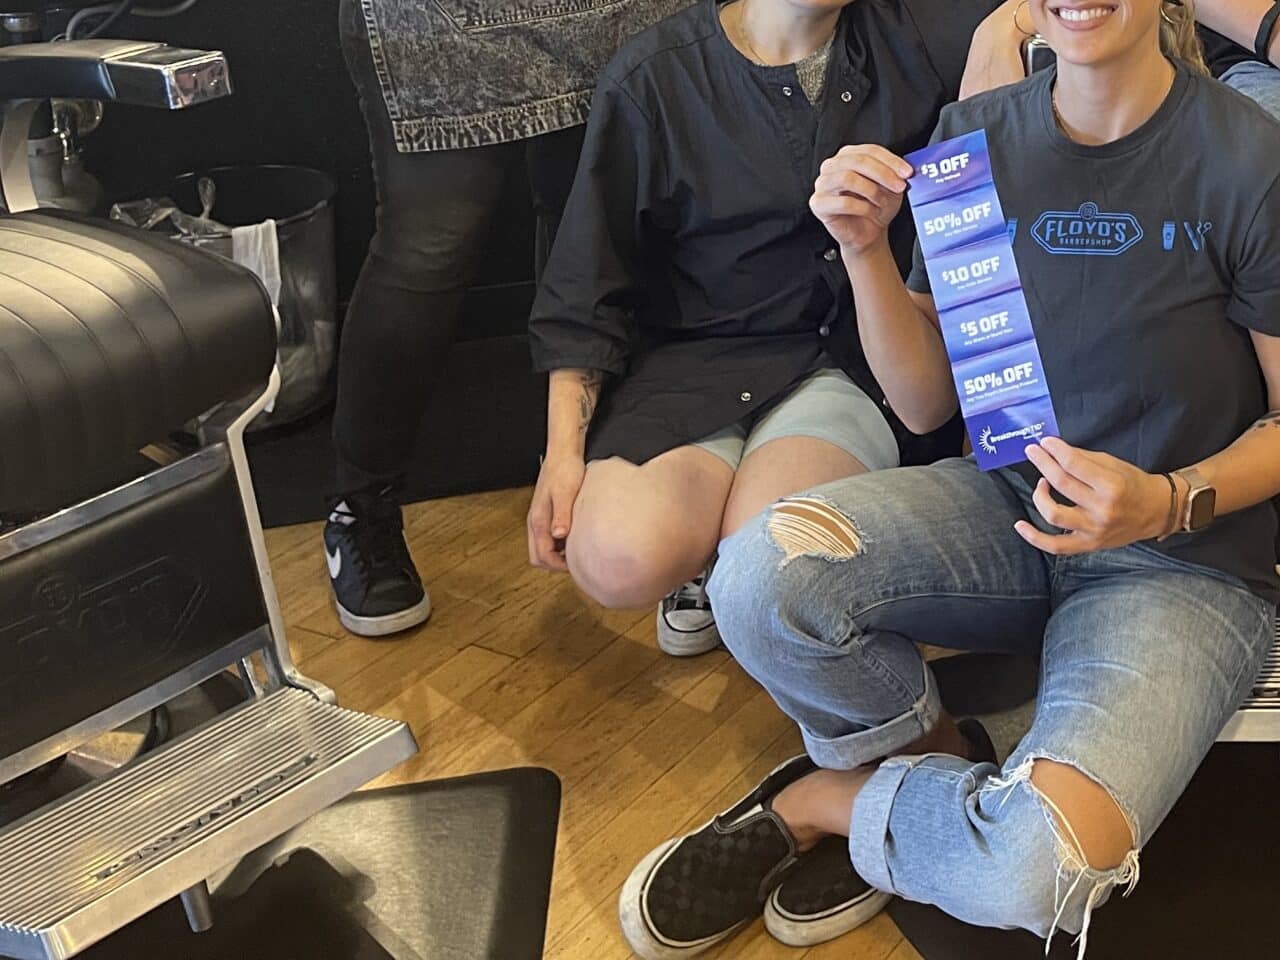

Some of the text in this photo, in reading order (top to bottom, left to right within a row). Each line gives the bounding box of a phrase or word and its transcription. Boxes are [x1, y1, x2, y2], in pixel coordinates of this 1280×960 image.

[921, 152, 970, 179] $3 OFF
[923, 213, 961, 236] 50%
[962, 202, 991, 223] OFF
[1045, 220, 1127, 243] FLOYD'S
[1060, 237, 1112, 246] BARBERSHOP
[942, 265, 970, 286] $10
[970, 256, 1000, 278] OFF
[960, 321, 978, 337] $5
[979, 311, 1009, 333] OFF
[963, 372, 1003, 395] 50%
[1003, 362, 1033, 383] OFF
